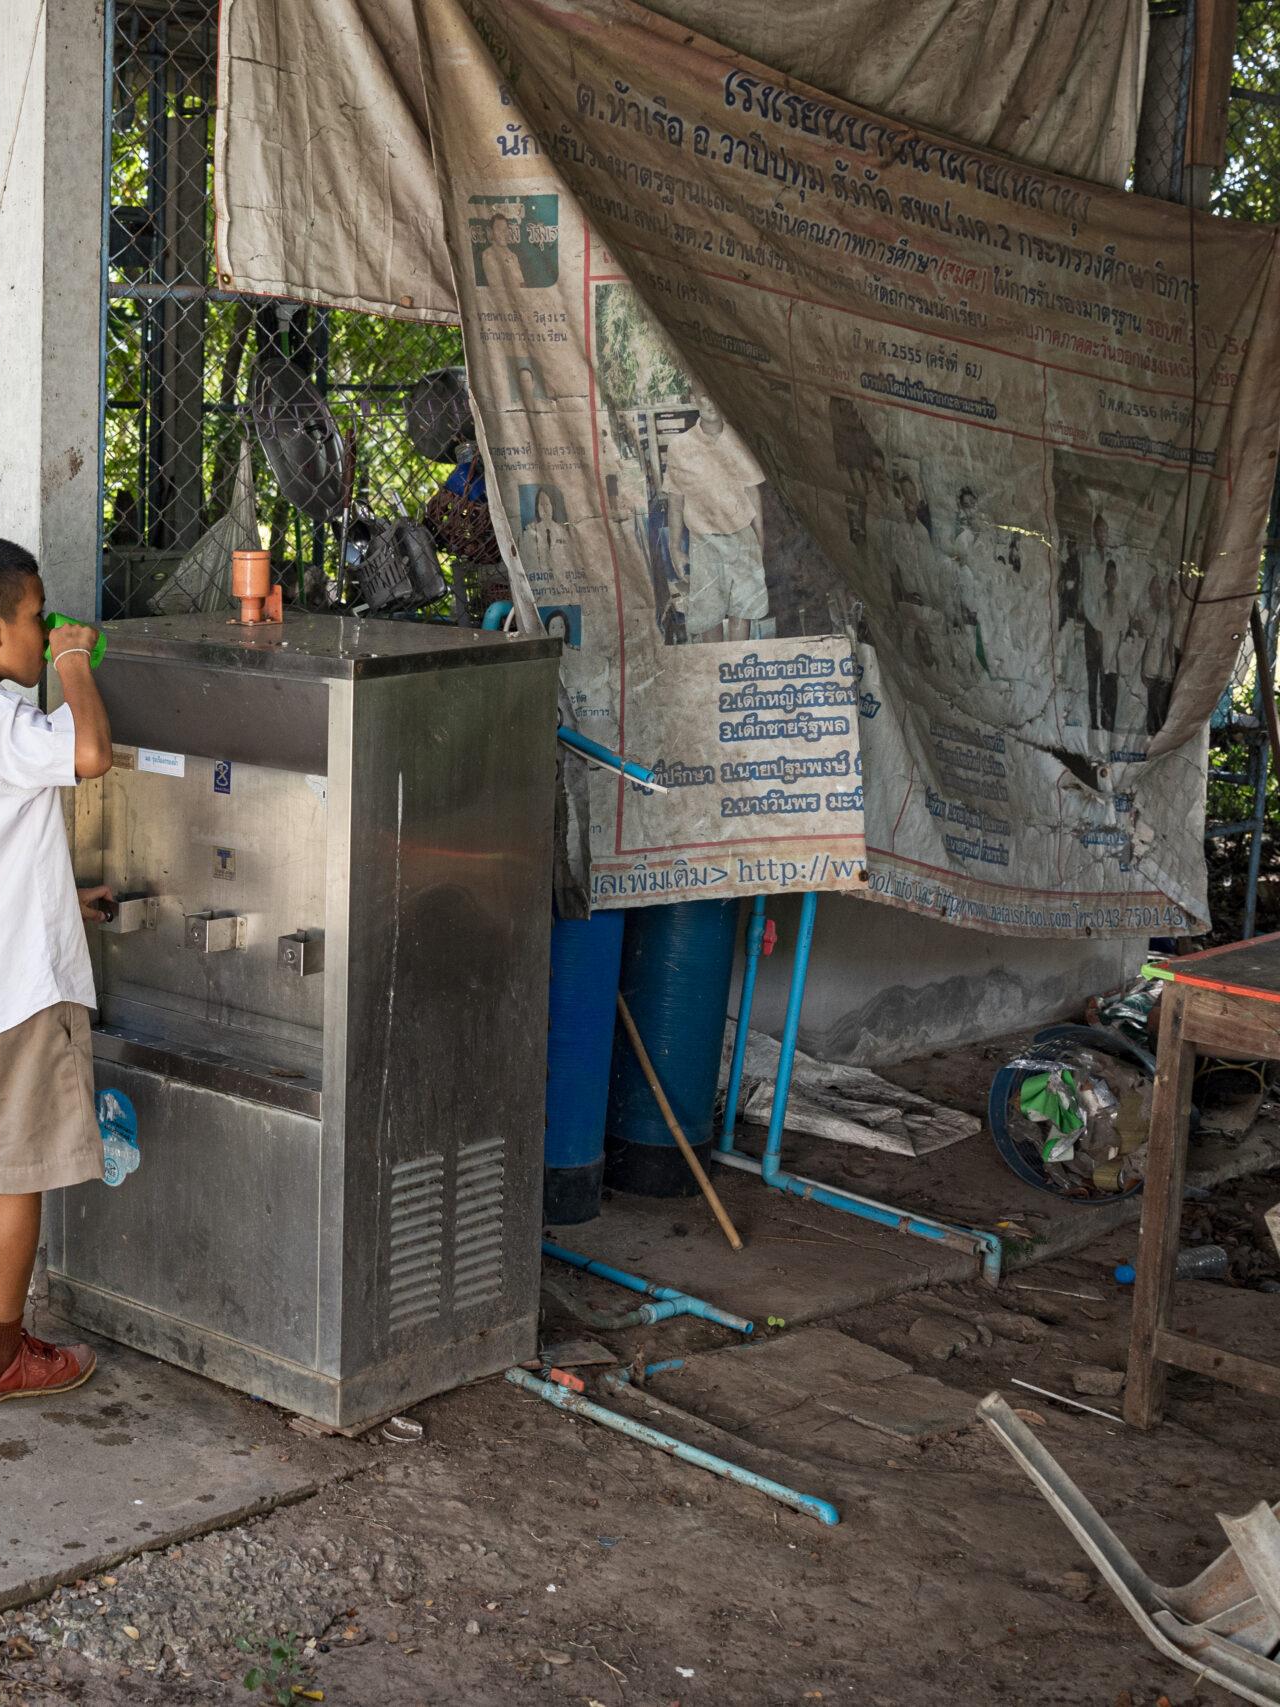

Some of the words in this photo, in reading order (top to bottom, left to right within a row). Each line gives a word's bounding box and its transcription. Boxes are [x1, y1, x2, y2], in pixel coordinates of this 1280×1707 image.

[721, 656, 833, 681] 1.เด็กชายปิยะ
[721, 715, 847, 741] 3.เด็กชายรัฐพล
[721, 754, 849, 783] 1.นายปฐมพงษ์
[722, 791, 818, 815] 2.นางวันพร
